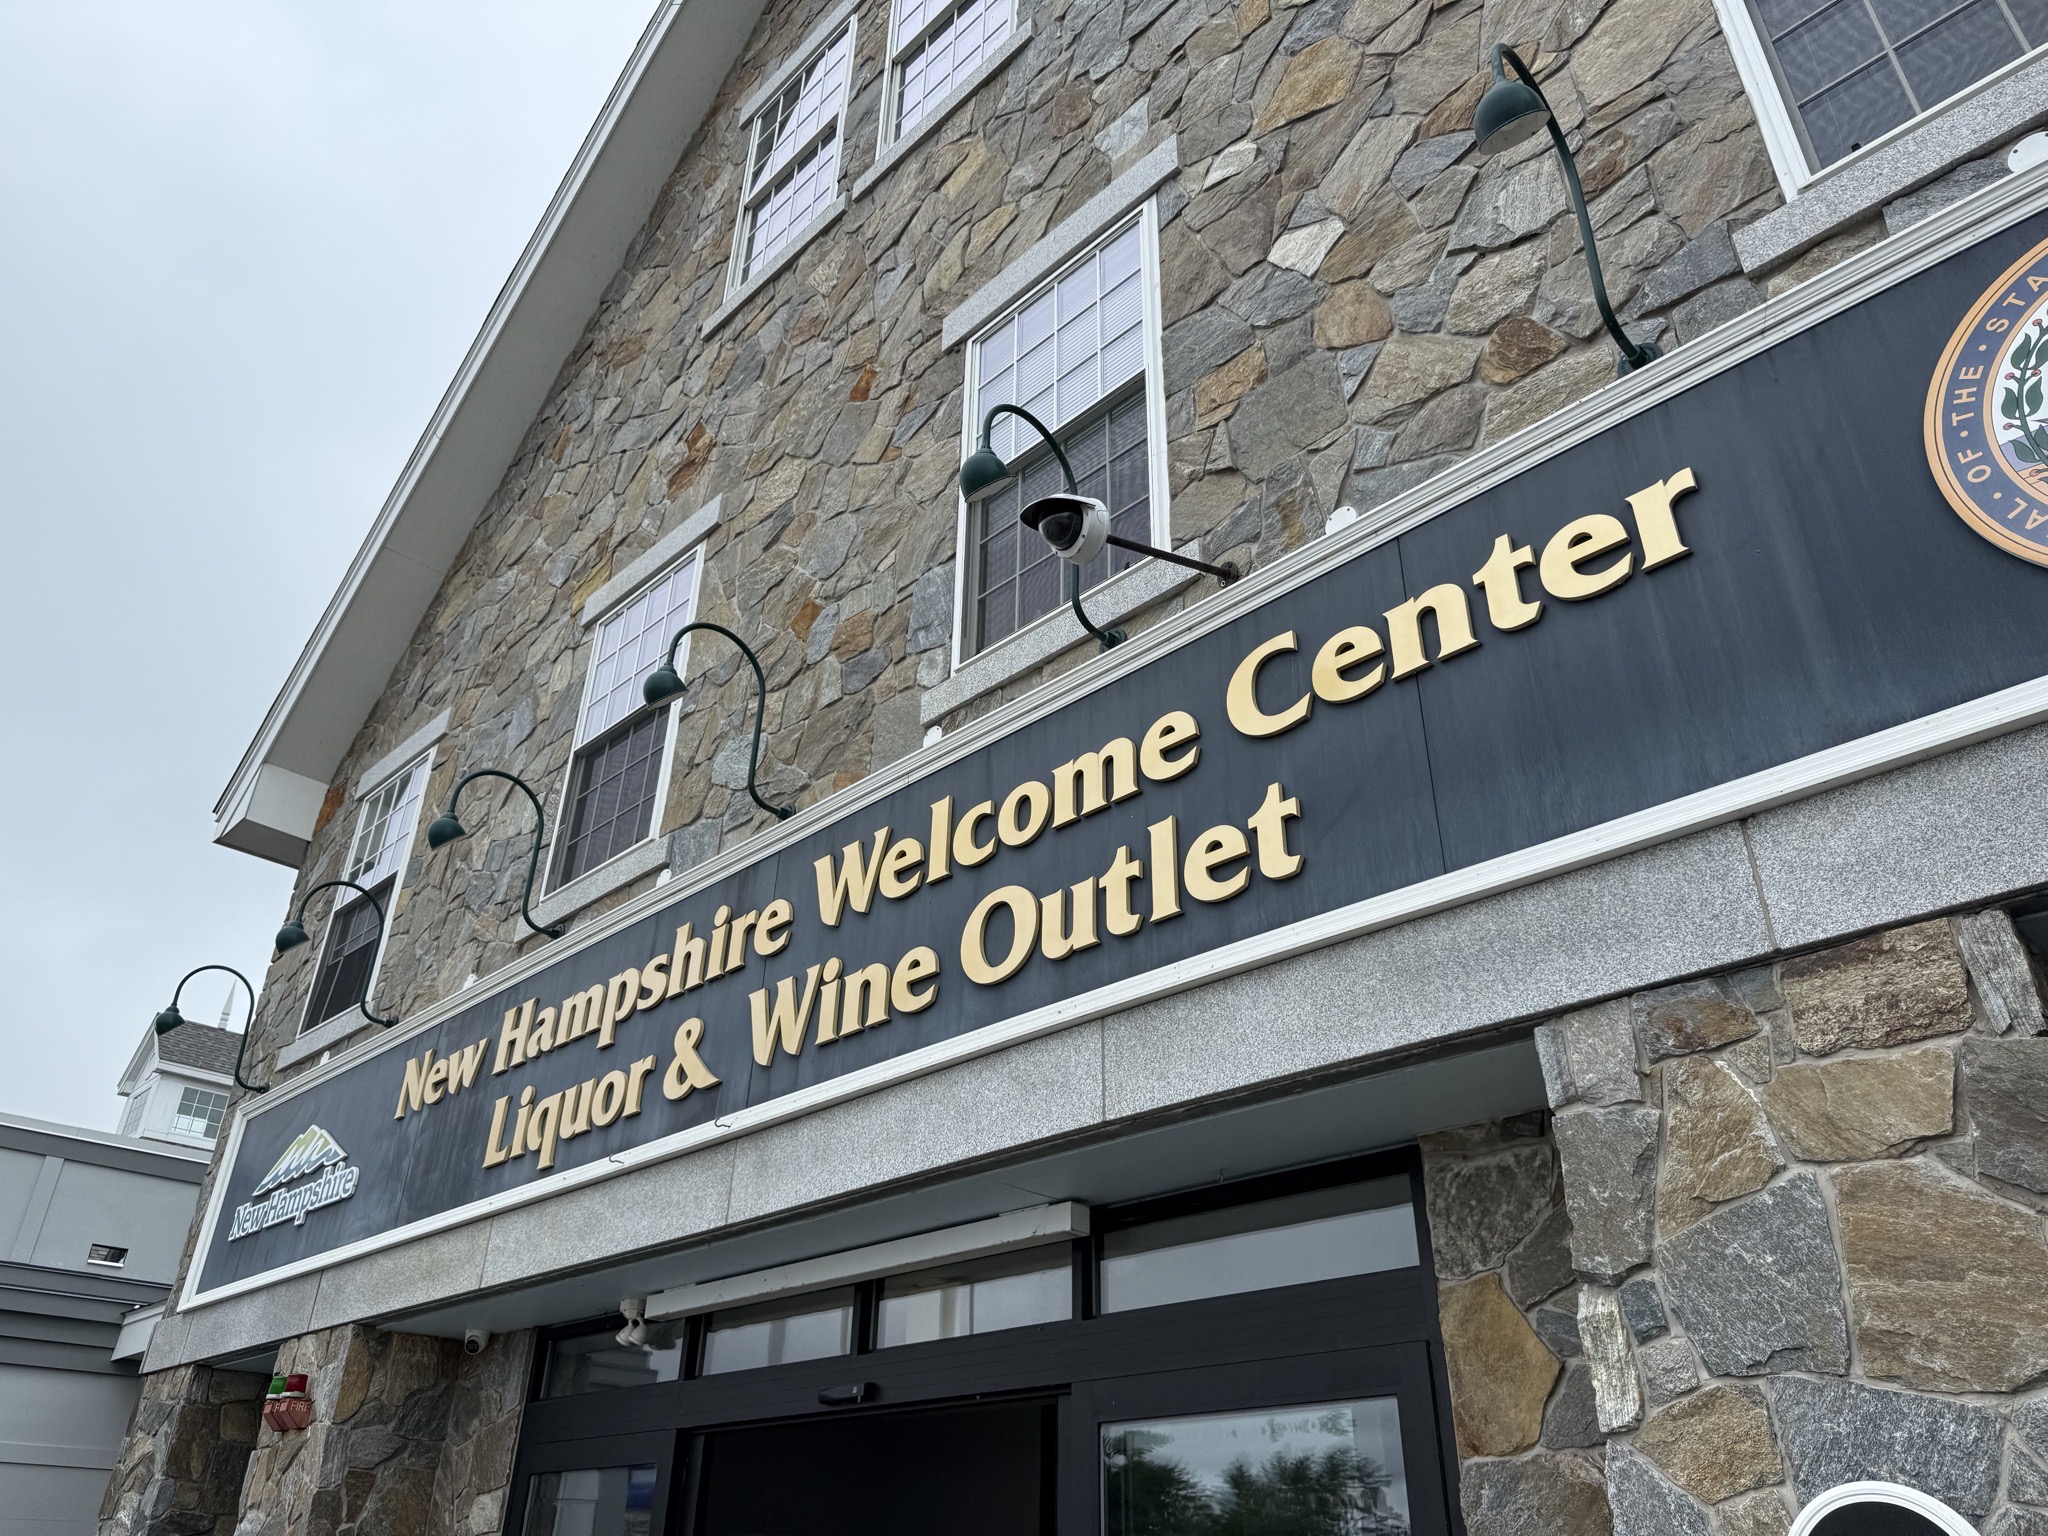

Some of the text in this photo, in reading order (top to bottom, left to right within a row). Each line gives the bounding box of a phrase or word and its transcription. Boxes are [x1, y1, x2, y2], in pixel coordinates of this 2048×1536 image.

[1951, 365, 1984, 427] THE
[1957, 449, 1992, 483] OF
[2007, 497, 2048, 538] AL
[393, 467, 1699, 1120] New Hampshire Welcome Center
[481, 782, 1305, 1171] Liquor & Wine Outlet
[228, 1160, 359, 1241] New Hampshire
[290, 1400, 311, 1412] FIRE
